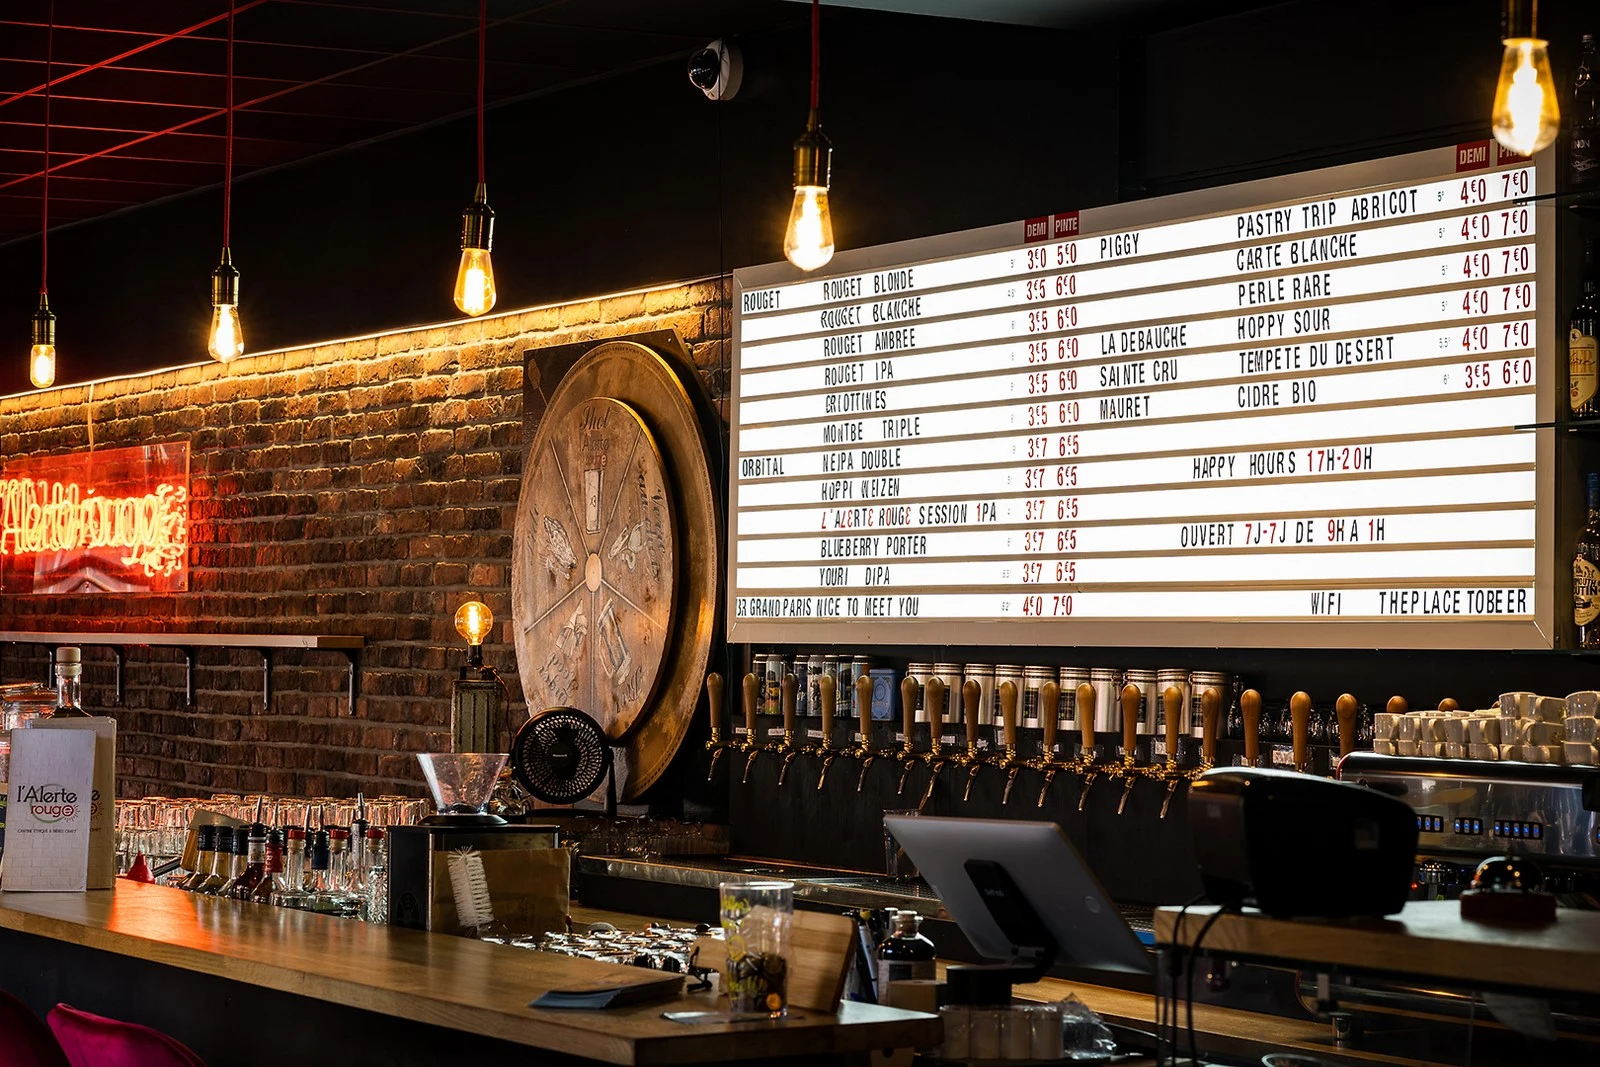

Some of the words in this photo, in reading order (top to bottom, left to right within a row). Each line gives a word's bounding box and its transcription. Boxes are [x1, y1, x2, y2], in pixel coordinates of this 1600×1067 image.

[1460, 146, 1486, 165] DEMI
[1056, 217, 1077, 232] PINTE
[1238, 209, 1291, 238] PASTRY
[1302, 202, 1336, 229] TRIP
[1351, 189, 1417, 221] ABRICOT
[1027, 222, 1046, 237] DEMI
[1101, 233, 1139, 259] PIGGY
[1237, 244, 1281, 270] CARTE
[1291, 234, 1357, 264] BLANCHE
[824, 277, 861, 300] ROUGET
[874, 269, 914, 294] BLONDE
[1238, 278, 1284, 306] PERLE
[1293, 274, 1331, 300] RARE
[744, 290, 780, 312] ROUGET
[821, 306, 861, 328] ROUGET
[873, 297, 921, 322] BLANCHE
[1238, 314, 1284, 340] HOPPY
[1294, 308, 1330, 334] SOUR
[824, 334, 862, 357] ROUGET
[875, 328, 915, 351] AMBREE
[1102, 333, 1116, 355] LA
[1121, 325, 1186, 353] DEBAUCHE
[1239, 346, 1300, 374] TEMPETE
[1310, 343, 1327, 367] DU
[1336, 336, 1394, 365] DESERT
[825, 363, 864, 386] ROUGET
[876, 360, 893, 381] IPA
[1100, 362, 1145, 387] SAINTE
[1153, 359, 1177, 382] CRU
[826, 390, 886, 413] GRIOTTINES
[1238, 384, 1279, 408] CIDRE
[1293, 380, 1316, 404] BIO
[1100, 395, 1150, 420] MAURET
[824, 422, 863, 443] MONTBE
[883, 417, 920, 439] TRIPLE
[742, 457, 784, 477] ORBITAL
[862, 448, 900, 469] DOUBLE
[1193, 455, 1235, 479] HAPPY
[1250, 451, 1295, 476] HOURS
[822, 480, 852, 500] HOPPI
[861, 478, 899, 498] WEIZEN
[879, 506, 911, 526] ROUGE
[919, 504, 967, 525] SESSION
[1181, 523, 1234, 548] OUVERT
[1296, 520, 1313, 543] DE
[1328, 519, 1344, 542] 9H
[1350, 519, 1358, 542] A
[1369, 518, 1384, 541] 1H
[821, 537, 879, 558] BLUEBERRY
[887, 536, 926, 555] PORTER
[820, 567, 848, 586] YOURI
[865, 566, 889, 585] DIPA
[750, 598, 780, 616] GRAND
[783, 598, 811, 616] PARIS
[817, 597, 840, 616] NICE
[847, 598, 858, 616] TO
[865, 597, 892, 616] MEET
[899, 597, 919, 616] YOU
[1311, 592, 1341, 615] WIFI
[17, 785, 78, 803] l'Alerte
[30, 804, 74, 818] rouge
